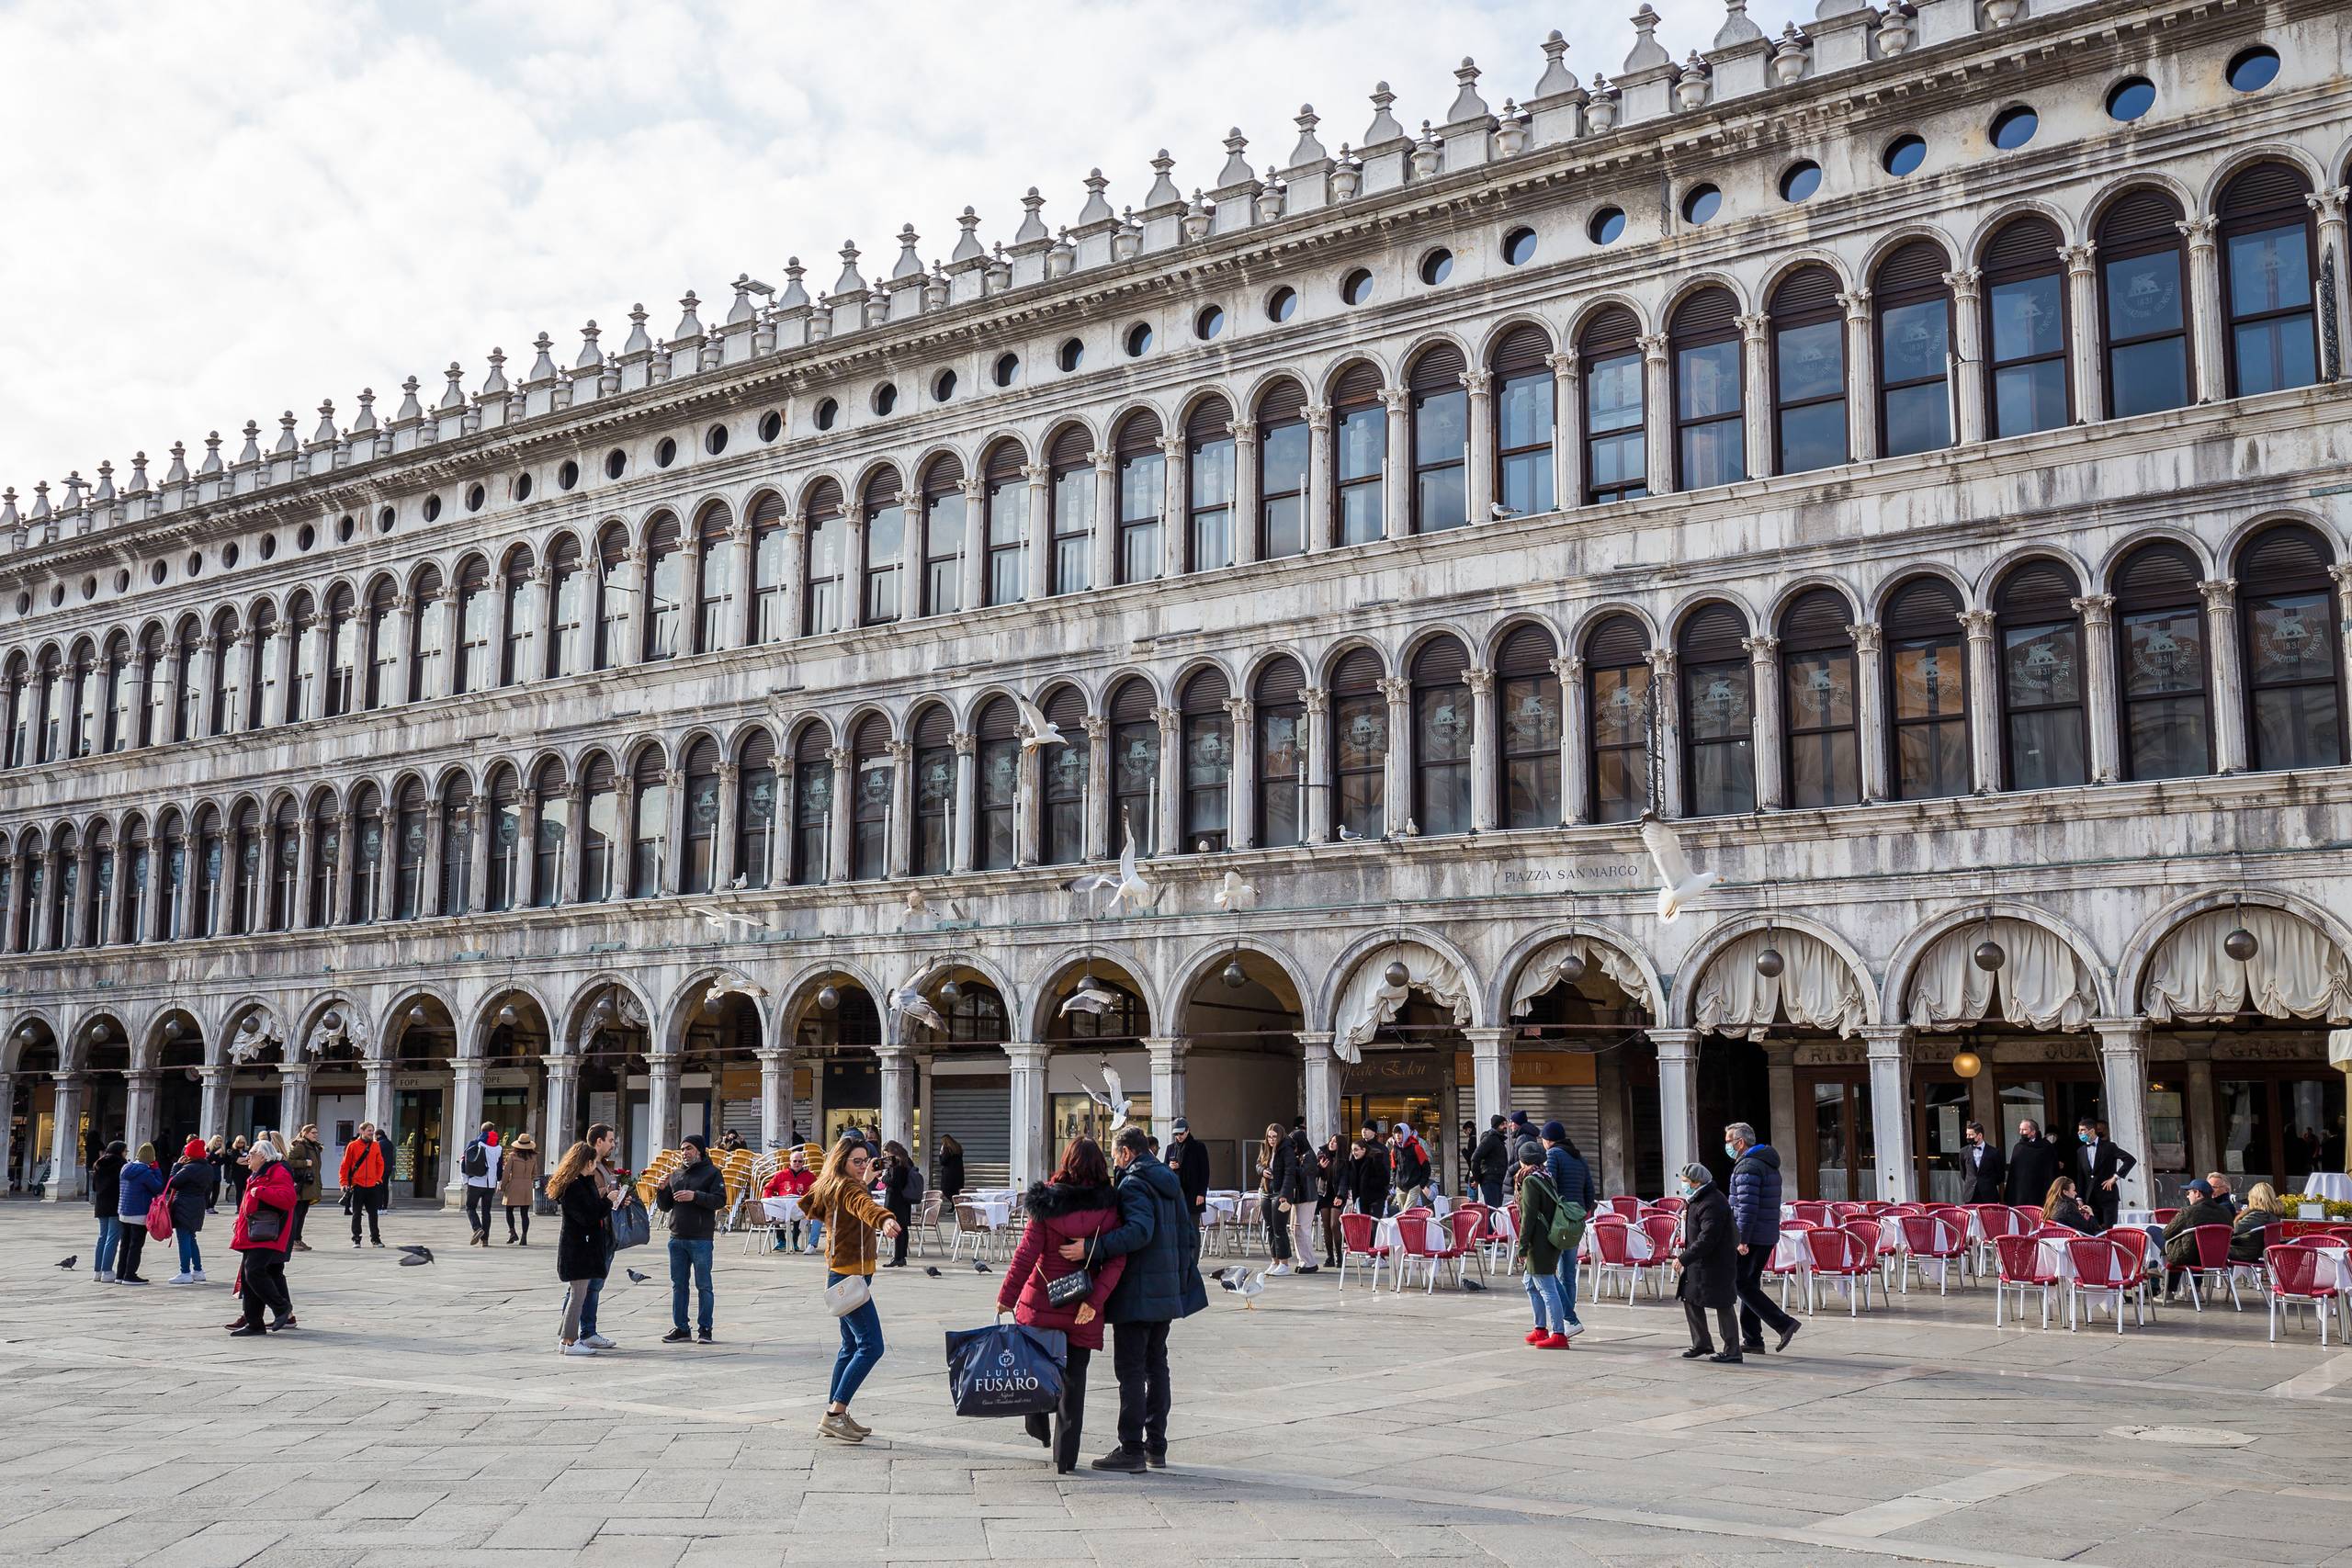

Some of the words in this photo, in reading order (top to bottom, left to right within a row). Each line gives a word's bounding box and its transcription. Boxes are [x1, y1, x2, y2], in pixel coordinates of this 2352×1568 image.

[2283, 641, 2300, 650] 1831
[2301, 626, 2324, 659] GENERALI
[2132, 647, 2169, 677] ASSICURAZIONI
[2173, 643, 2192, 672] GENERALI
[2155, 653, 2171, 663] 1831
[2035, 668, 2051, 677] 1831
[2052, 653, 2071, 684] GENERALI
[1505, 870, 1552, 883] PIAZZA
[1557, 867, 1585, 880] SAN
[1589, 865, 1638, 878] MARCO
[1381, 1060, 1426, 1076] Eden
[400, 1078, 420, 1087] FOPE
[484, 1076, 501, 1084] OPE
[986, 1368, 1027, 1377] LUIGI
[975, 1376, 1039, 1392] FUSARO
